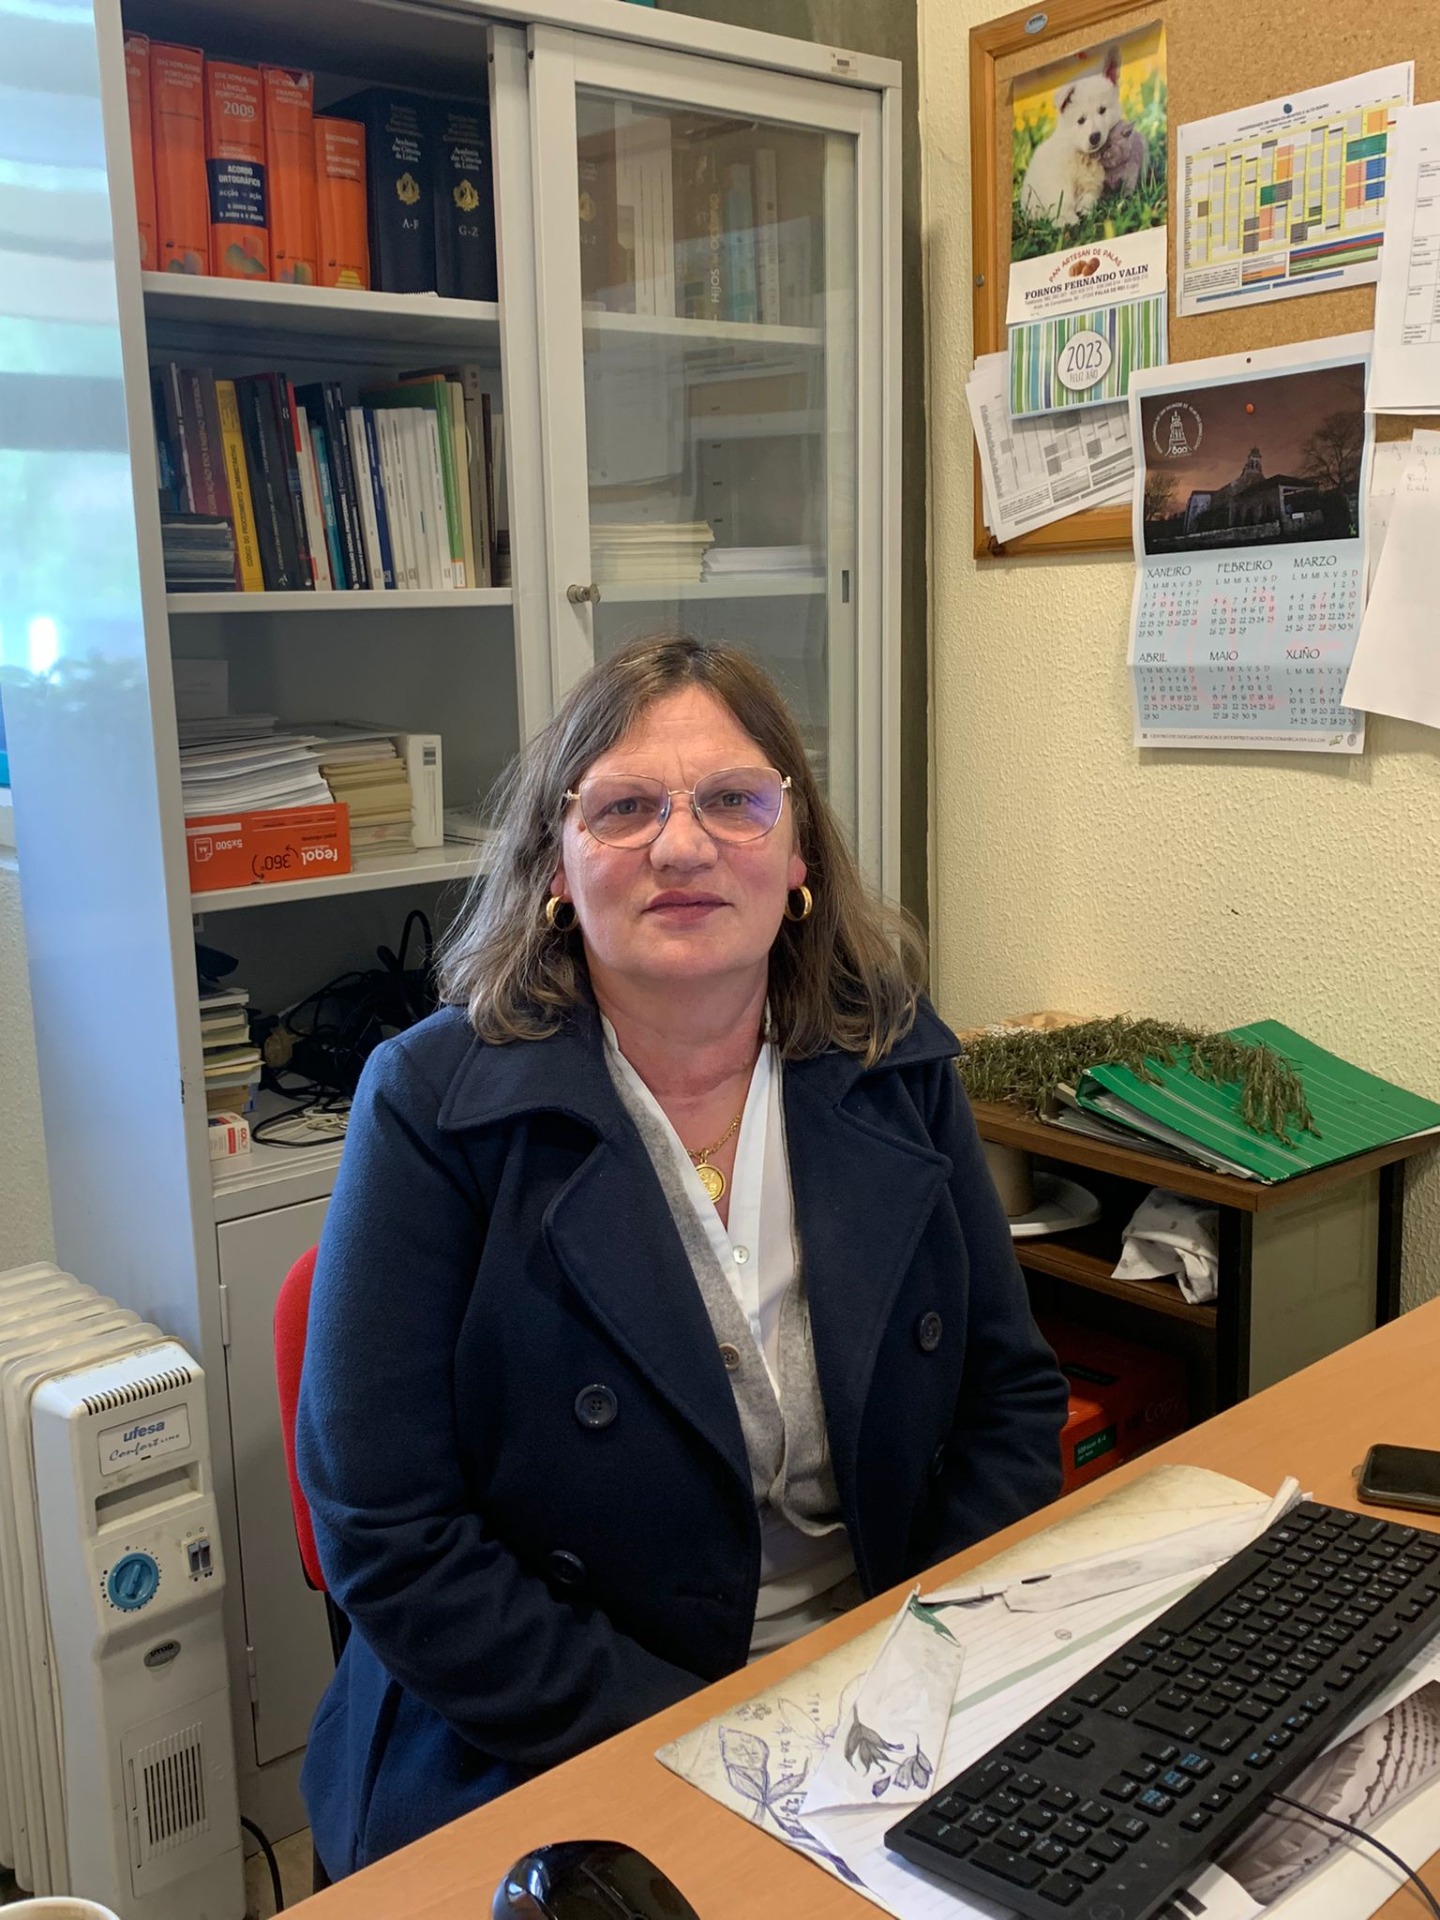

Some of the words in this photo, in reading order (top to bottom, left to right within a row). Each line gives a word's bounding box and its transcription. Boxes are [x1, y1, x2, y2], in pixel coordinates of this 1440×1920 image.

[224, 102, 254, 118] 2009
[228, 165, 253, 175] ACORDO
[218, 175, 260, 187] ORTOGRÁFICO
[403, 219, 419, 229] A-F
[459, 226, 478, 238] G-Z
[1048, 268, 1060, 282] PAN
[1062, 248, 1090, 267] ARTESAN
[1093, 248, 1100, 256] DE
[1103, 249, 1122, 267] PALAS
[1024, 285, 1062, 300] FORNOS
[1064, 272, 1116, 290] FERNANDO
[1119, 264, 1149, 278] VALIN
[1066, 340, 1102, 373] 2023
[1070, 372, 1084, 383] FELIZ
[1086, 369, 1099, 380] AÑO
[198, 420, 208, 451] ENSINO
[202, 452, 212, 467] DO
[230, 444, 243, 489] ADMINISTRATIVO
[1218, 560, 1272, 573] FEBREIRO
[1294, 555, 1337, 568] MARZO
[1148, 565, 1191, 578] XANEIRO
[1138, 652, 1167, 662] ABRIL
[1210, 650, 1238, 660] MAIO
[1286, 646, 1320, 659] XUÑO
[215, 839, 243, 850] 5x500
[1145, 1396, 1180, 1422] Copy
[123, 1421, 165, 1442] ufesa
[109, 1438, 158, 1461] Confort
